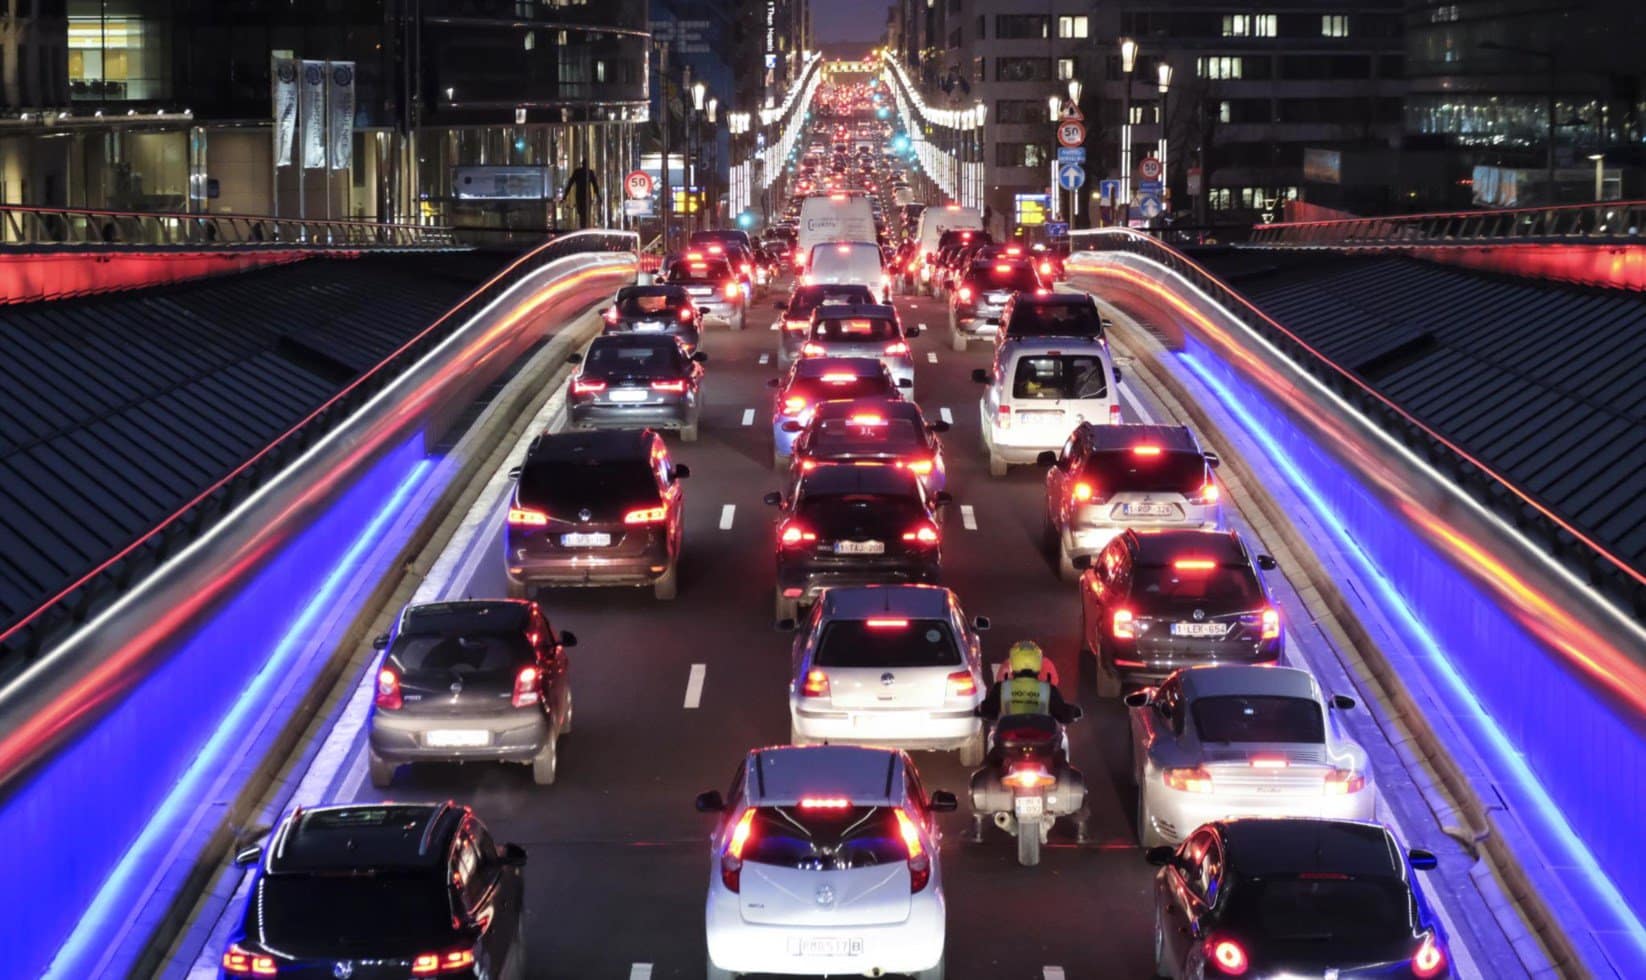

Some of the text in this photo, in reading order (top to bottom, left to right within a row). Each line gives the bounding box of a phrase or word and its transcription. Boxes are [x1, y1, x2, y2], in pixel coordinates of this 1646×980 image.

[1065, 127, 1079, 136] 50
[1145, 163, 1157, 172] 50
[631, 177, 646, 187] 50
